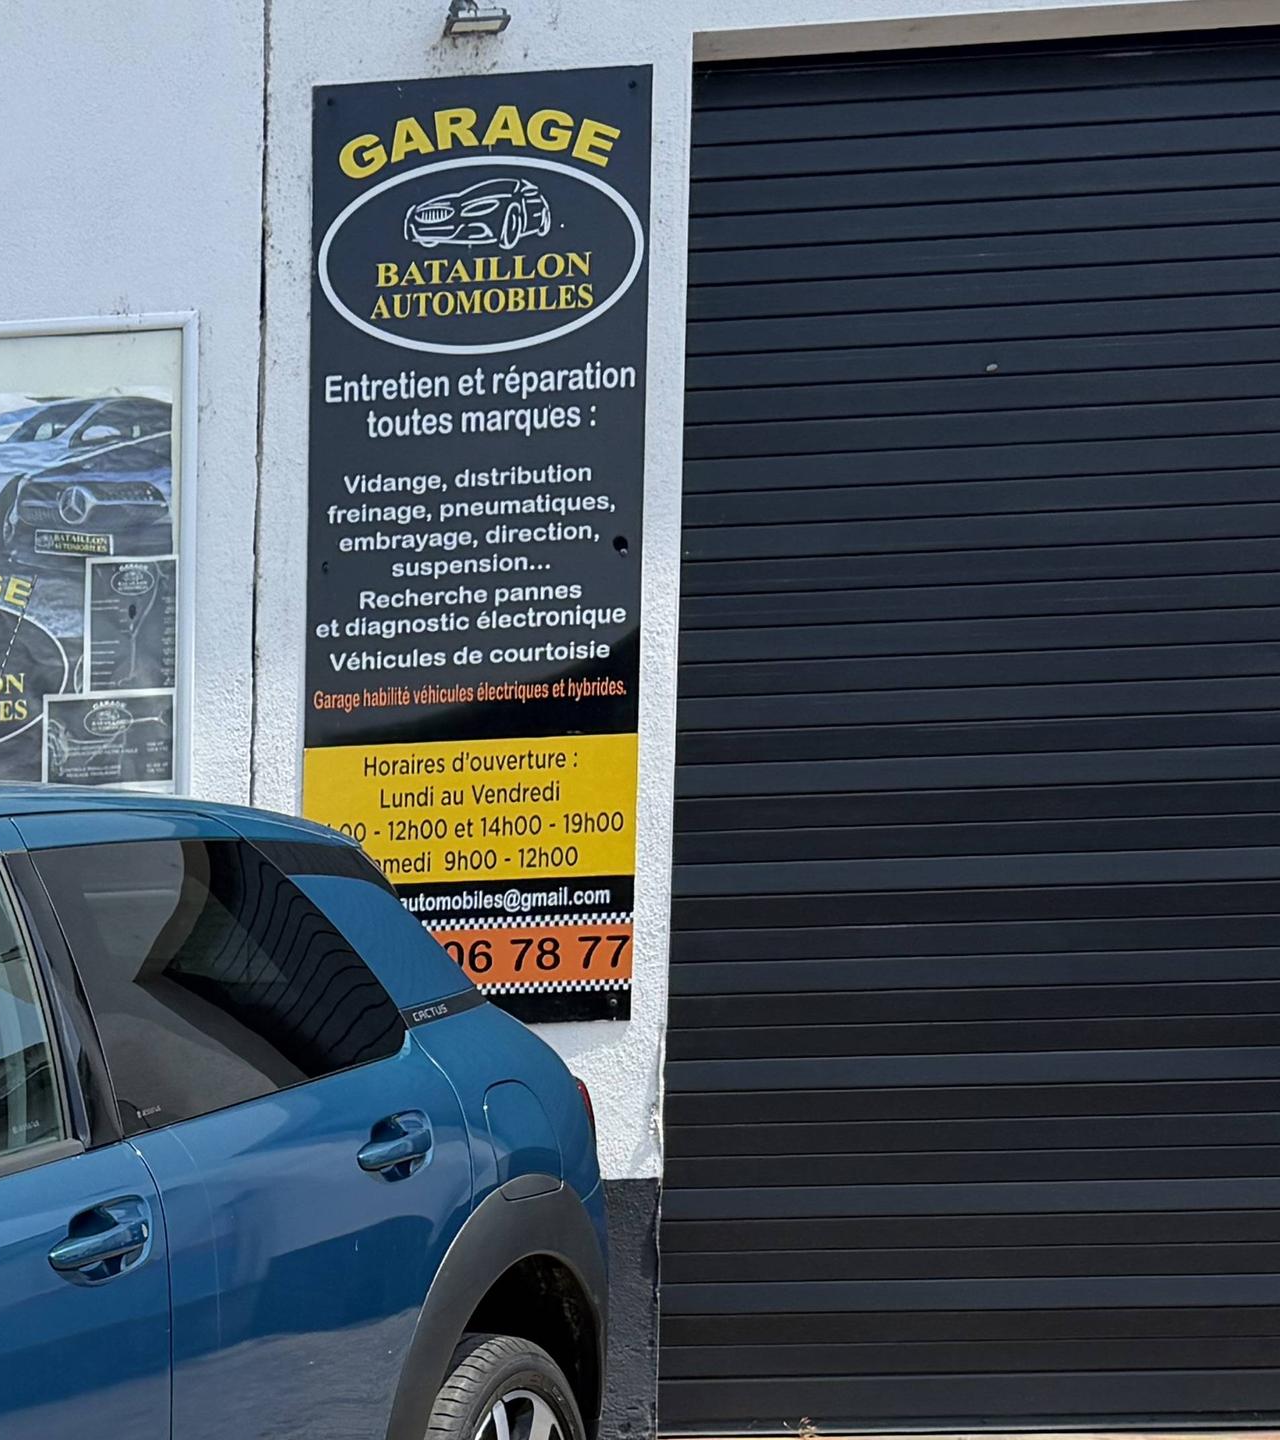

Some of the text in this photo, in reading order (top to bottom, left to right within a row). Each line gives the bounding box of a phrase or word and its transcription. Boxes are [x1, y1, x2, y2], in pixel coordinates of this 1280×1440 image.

[339, 105, 621, 179] GARAGE
[376, 252, 592, 288] BATAILLON
[370, 284, 593, 320] AUTOMOBILES
[324, 361, 636, 403] Entretien et réparation
[366, 407, 453, 438] toutes
[461, 406, 581, 437] marques
[344, 464, 592, 495] Vidange, distribution
[327, 494, 616, 525] freinage, pneumatiques,
[339, 522, 600, 552] embrayage, direction,
[391, 554, 551, 579] suspension...
[359, 584, 582, 610] Recherche pannes
[316, 605, 627, 640] et diagnostic électronique
[329, 641, 611, 671] Véhicules de courtoisie
[314, 677, 627, 713] Garage habilité véhicules électriques et hybrides.
[364, 755, 445, 777] Horaires
[452, 751, 567, 775] d'ouverture
[380, 781, 561, 808] Lundi au Vendredi
[388, 820, 448, 842] 12h00
[454, 819, 474, 838] et
[481, 816, 542, 837] 14h00
[563, 811, 625, 834] 19h00
[444, 849, 497, 871] 9h00
[519, 846, 579, 868] 12h00
[510, 937, 561, 972] 78
[578, 935, 630, 969] 77
[412, 1003, 448, 1022] CACTUS
